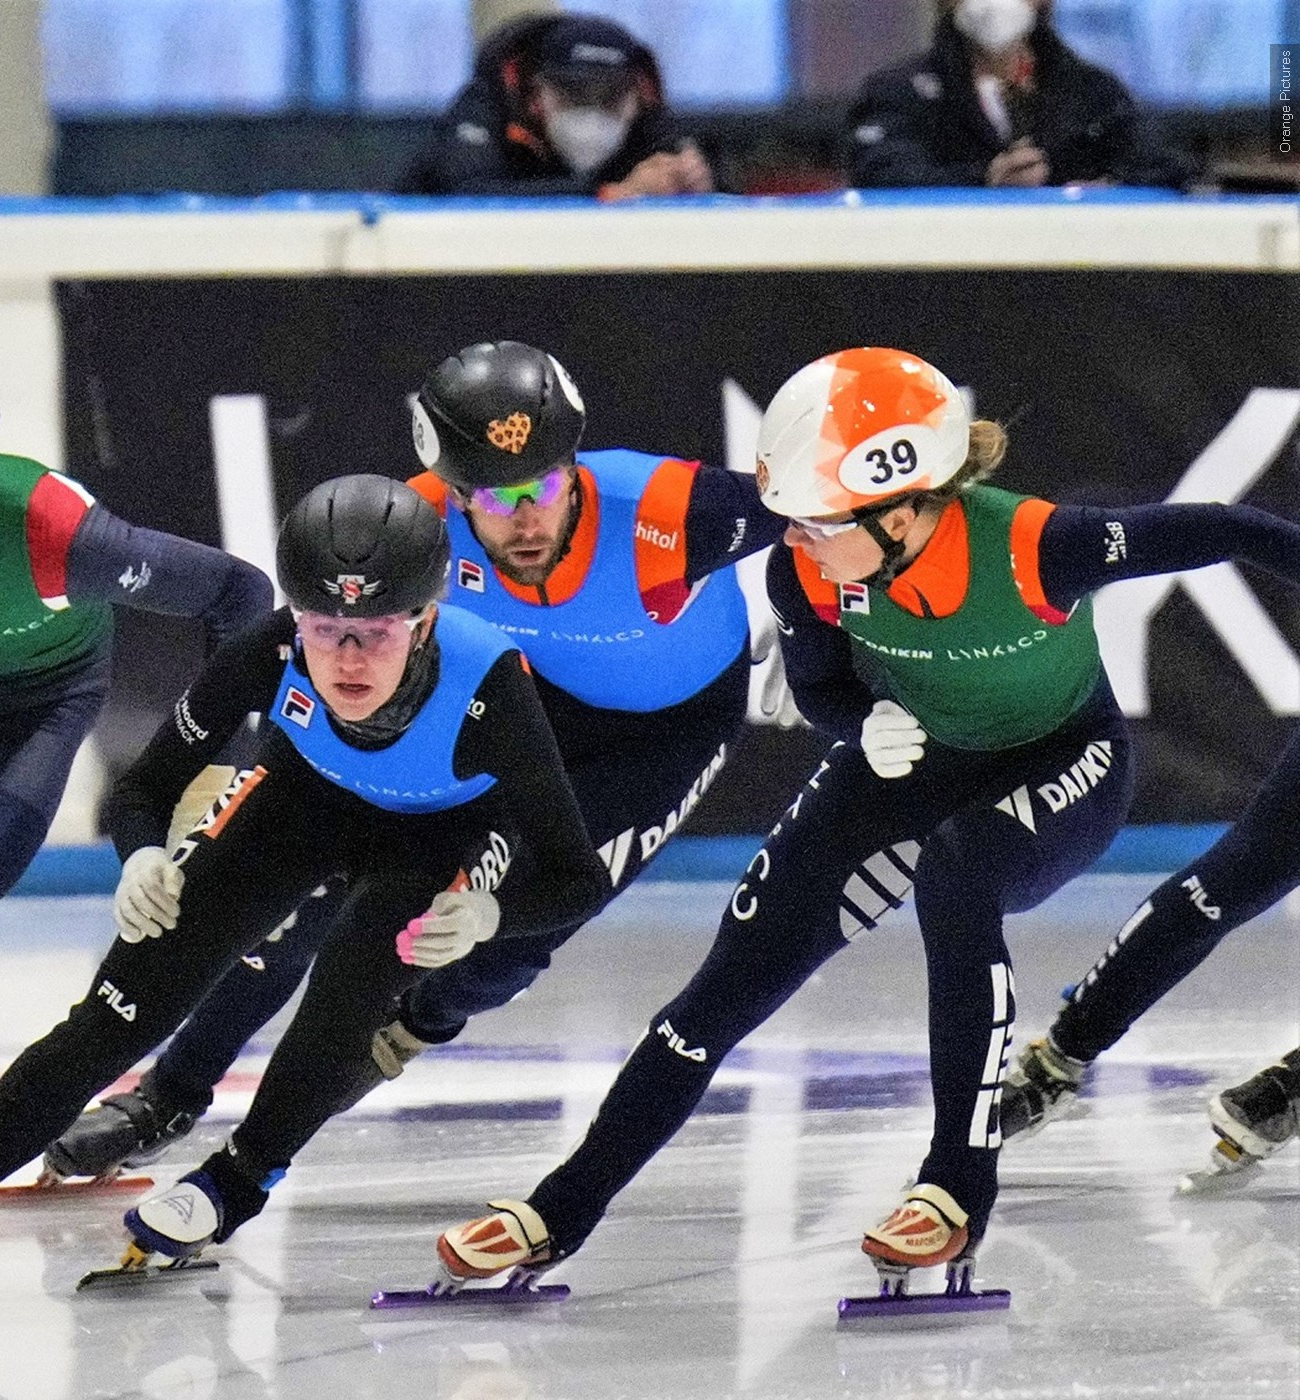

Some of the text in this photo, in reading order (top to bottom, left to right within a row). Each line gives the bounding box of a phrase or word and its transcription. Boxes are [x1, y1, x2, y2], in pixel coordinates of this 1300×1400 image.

[865, 439, 918, 485] 39
[635, 521, 678, 552] hitol
[865, 640, 934, 660] DAIKIN
[1181, 875, 1221, 920] FILA
[97, 979, 137, 1022] FILA
[656, 1019, 707, 1062] FILA
